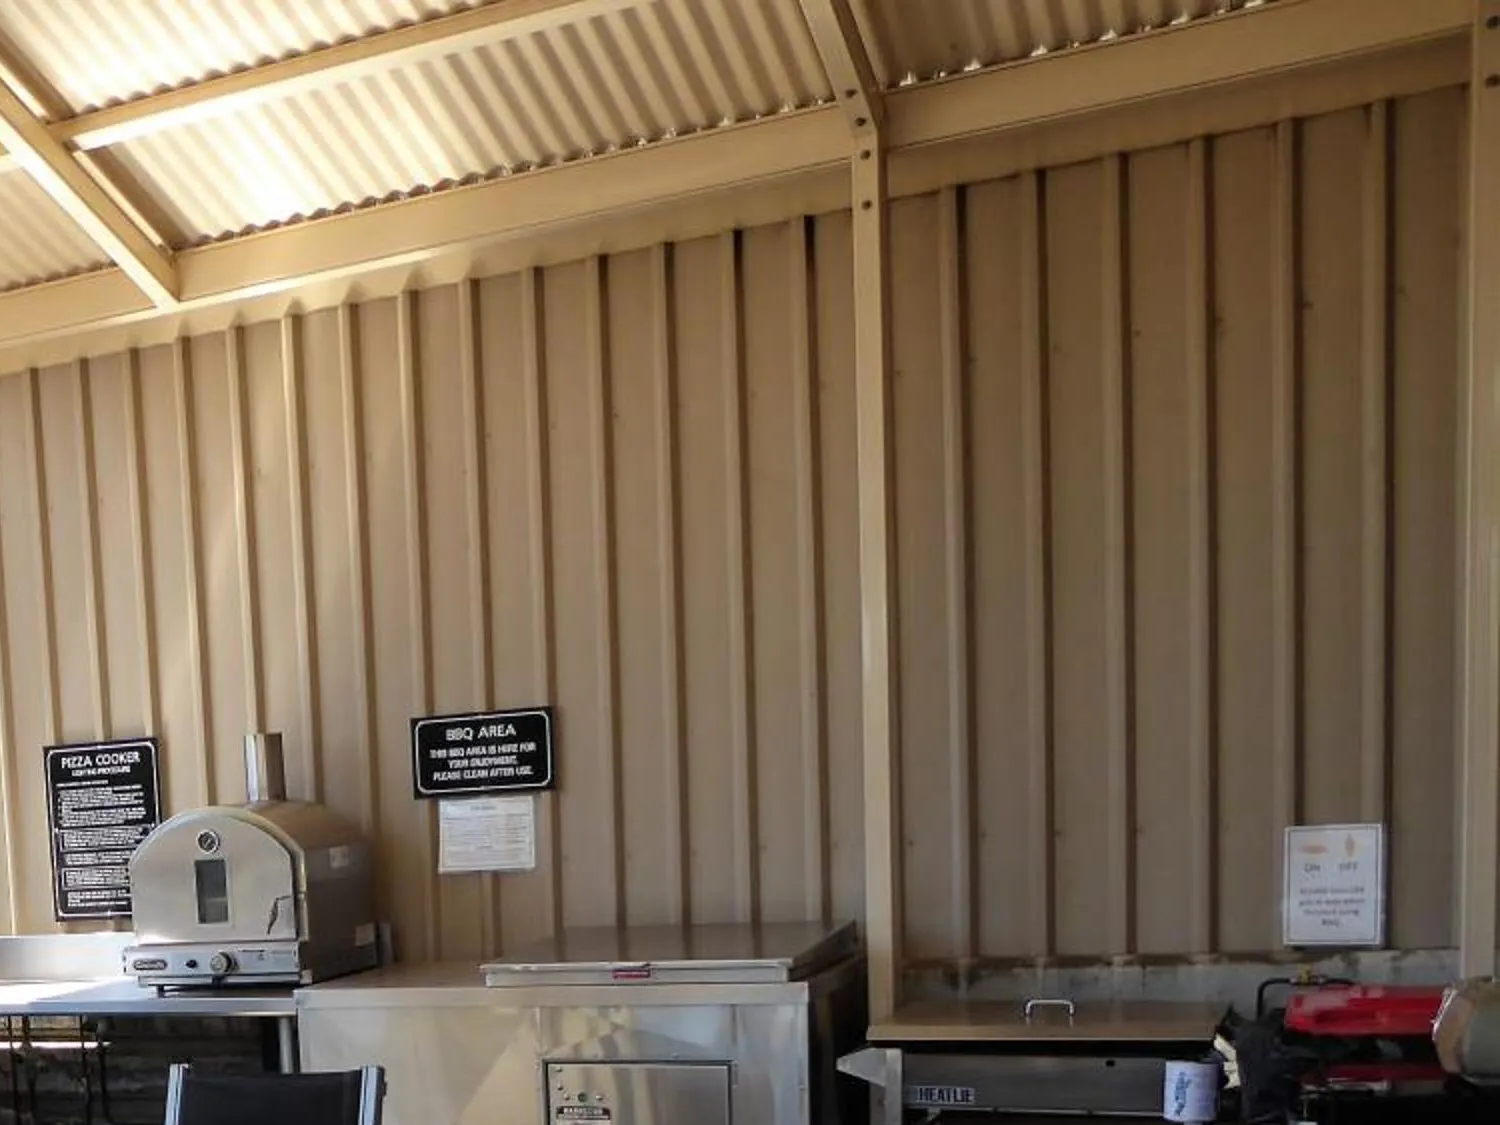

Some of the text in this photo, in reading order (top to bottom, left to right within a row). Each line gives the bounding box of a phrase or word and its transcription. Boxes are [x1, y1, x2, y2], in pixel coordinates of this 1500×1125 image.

[446, 723, 517, 741] BBQ AREA
[466, 745, 487, 756] AREA
[520, 742, 536, 752] FOR
[61, 751, 141, 769] PIZZA COOKER
[433, 771, 461, 781] PLEASE
